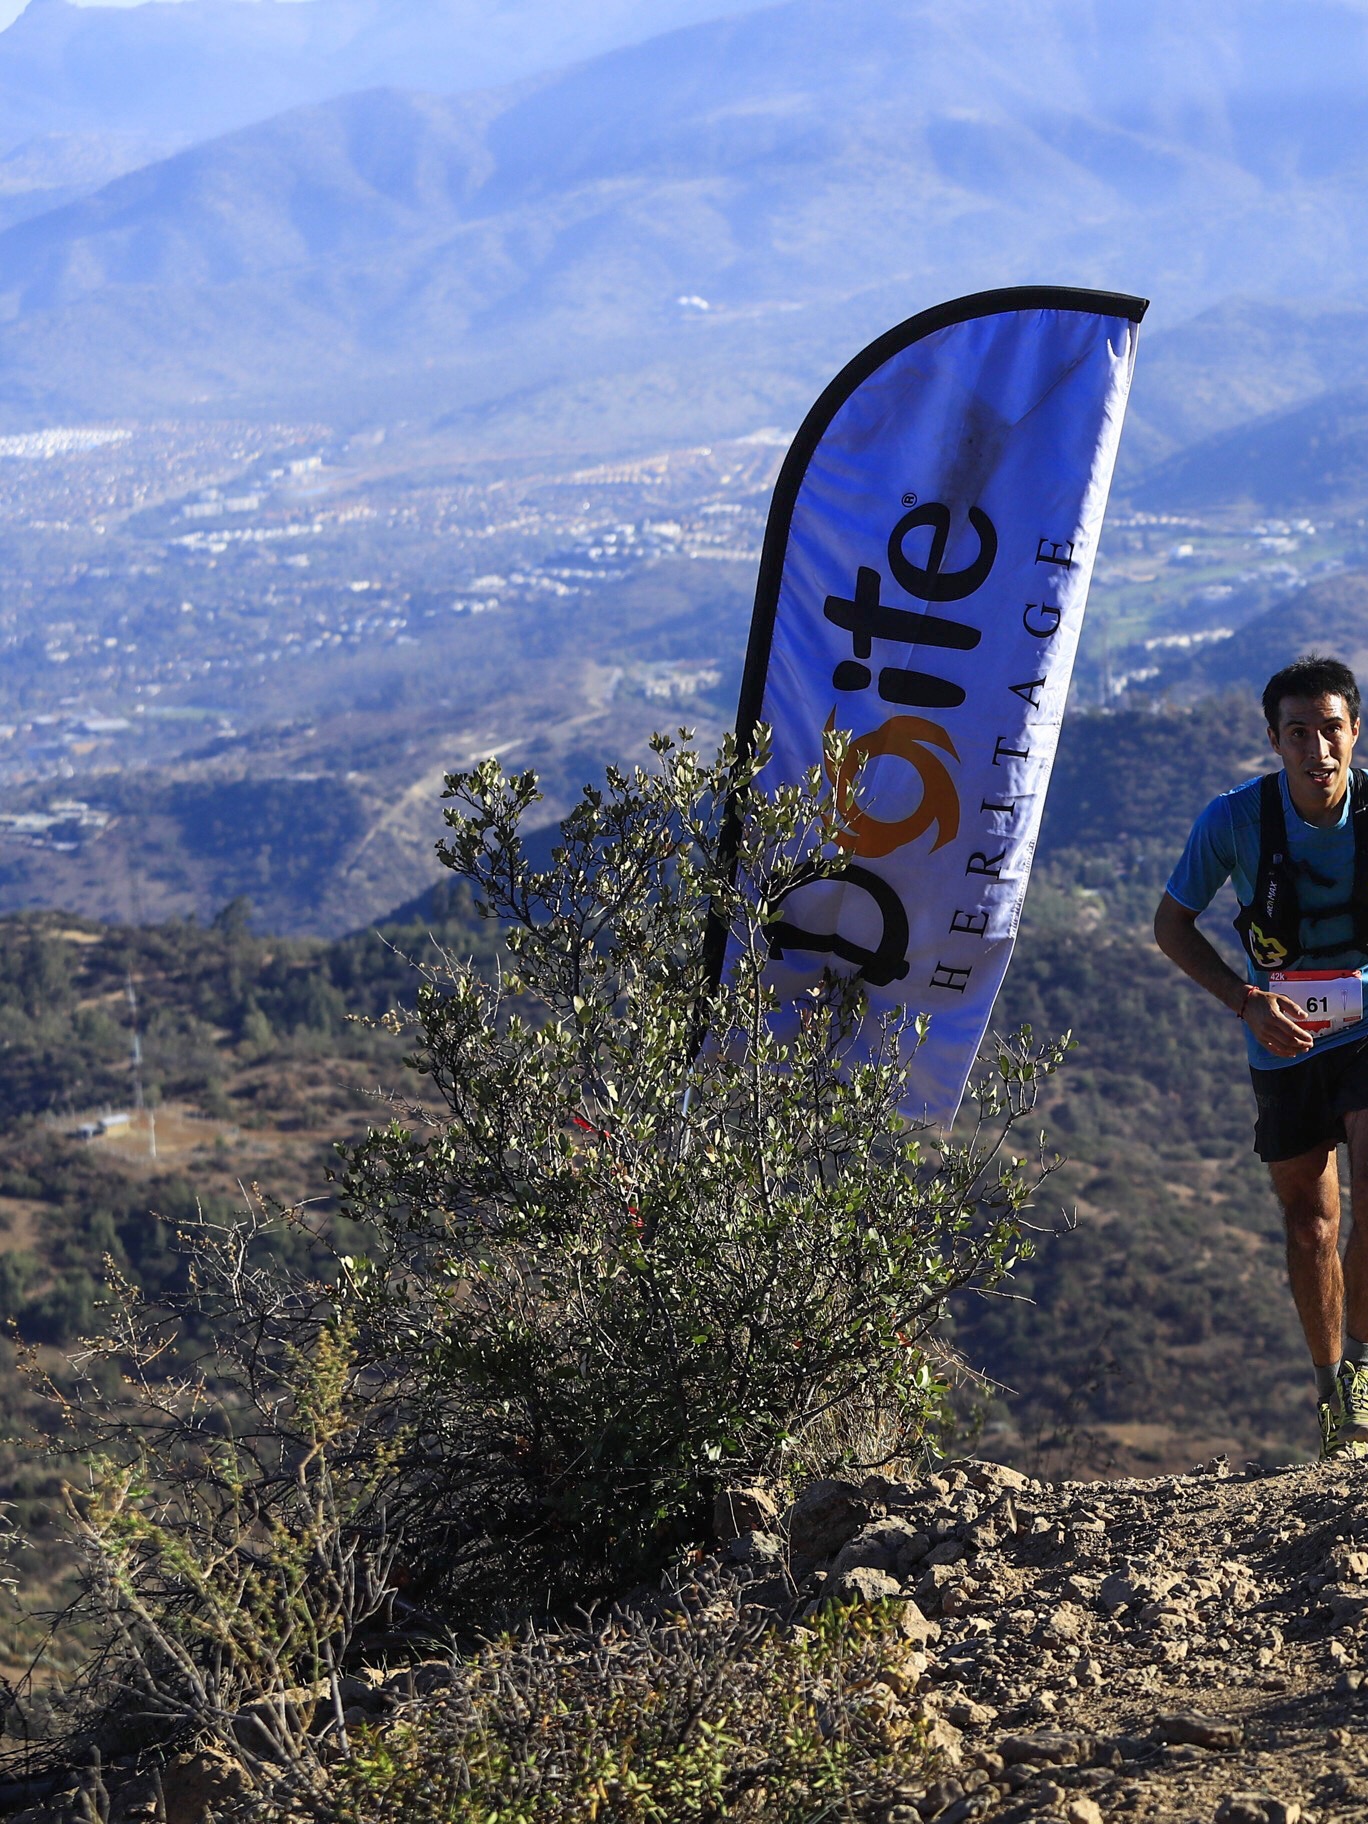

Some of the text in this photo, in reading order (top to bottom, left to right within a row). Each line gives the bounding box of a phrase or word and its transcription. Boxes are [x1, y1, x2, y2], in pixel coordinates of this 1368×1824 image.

[767, 502, 998, 988] Doite
[930, 539, 1075, 994] HERITAGE
[1306, 996, 1328, 1013] 61
